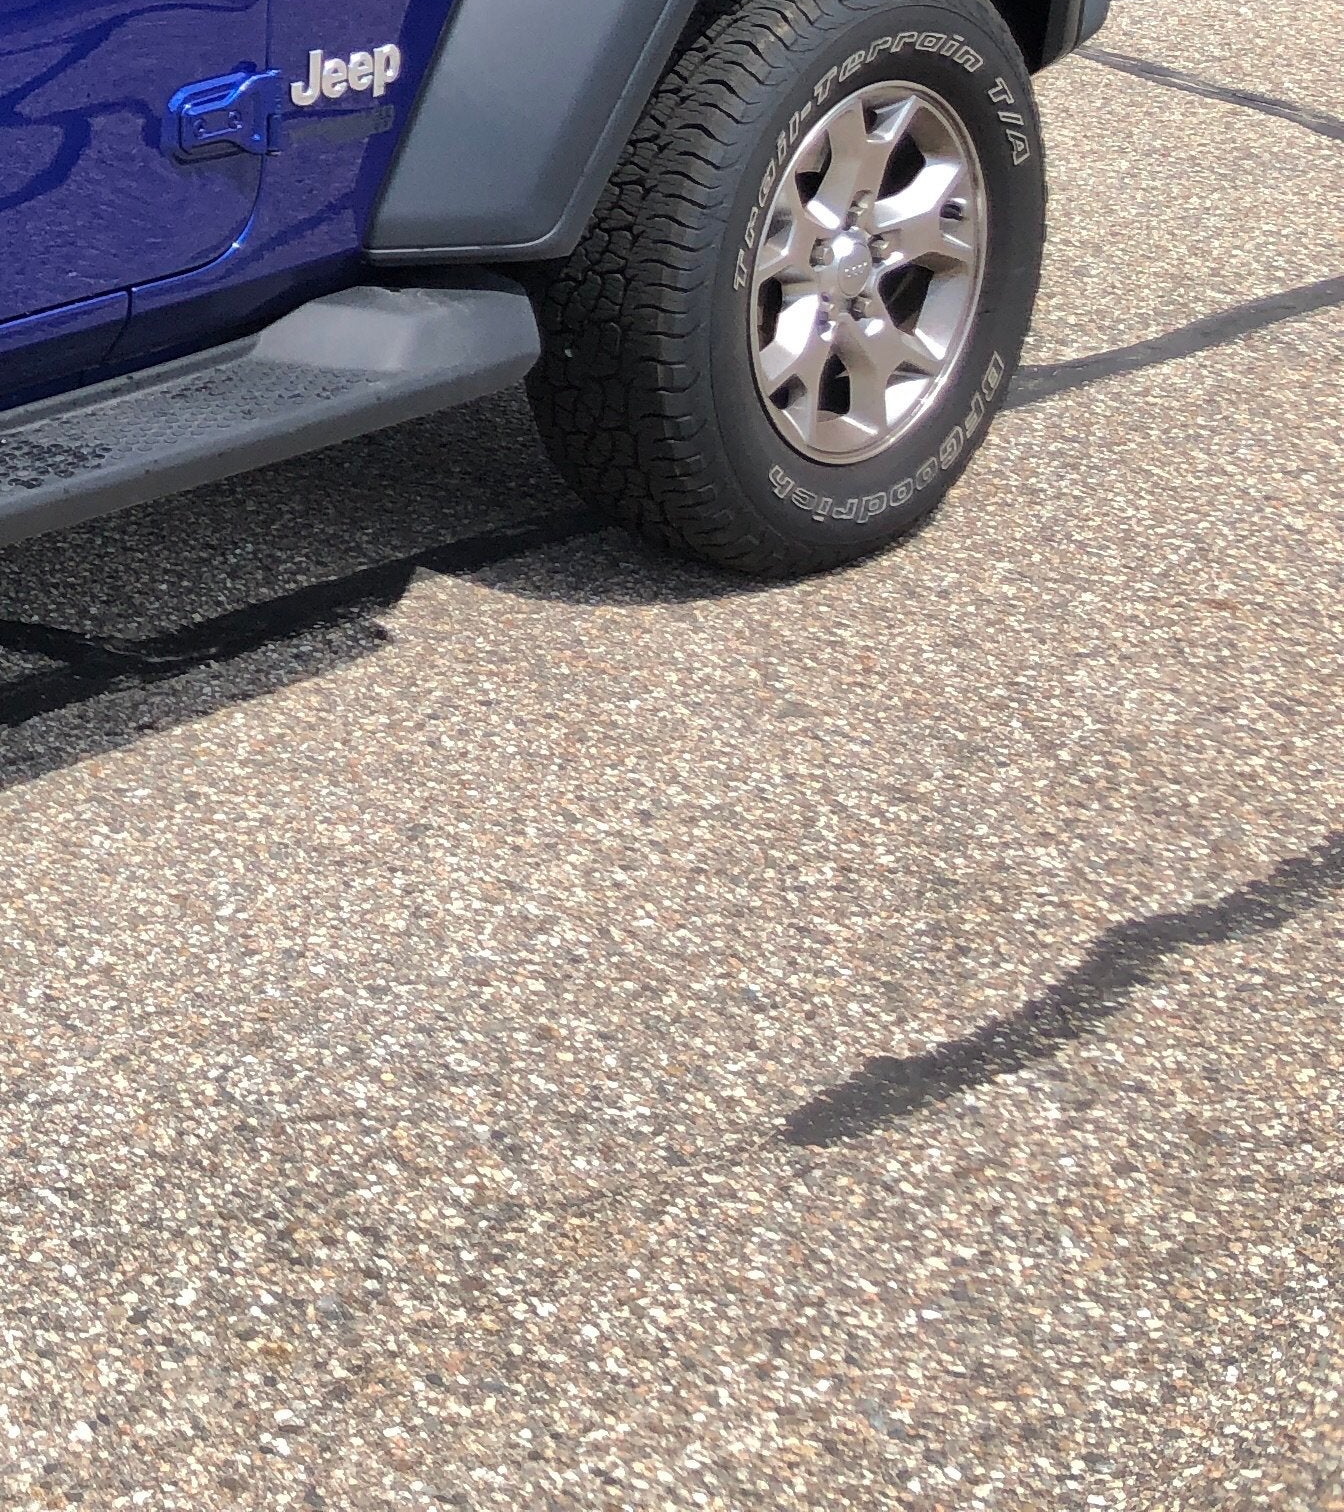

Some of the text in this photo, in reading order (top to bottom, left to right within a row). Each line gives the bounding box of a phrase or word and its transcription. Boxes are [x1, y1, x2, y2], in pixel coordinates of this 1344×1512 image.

[289, 43, 401, 107] Jeep
[986, 77, 1031, 166] T/A
[768, 350, 1006, 524] BFGoodrich
